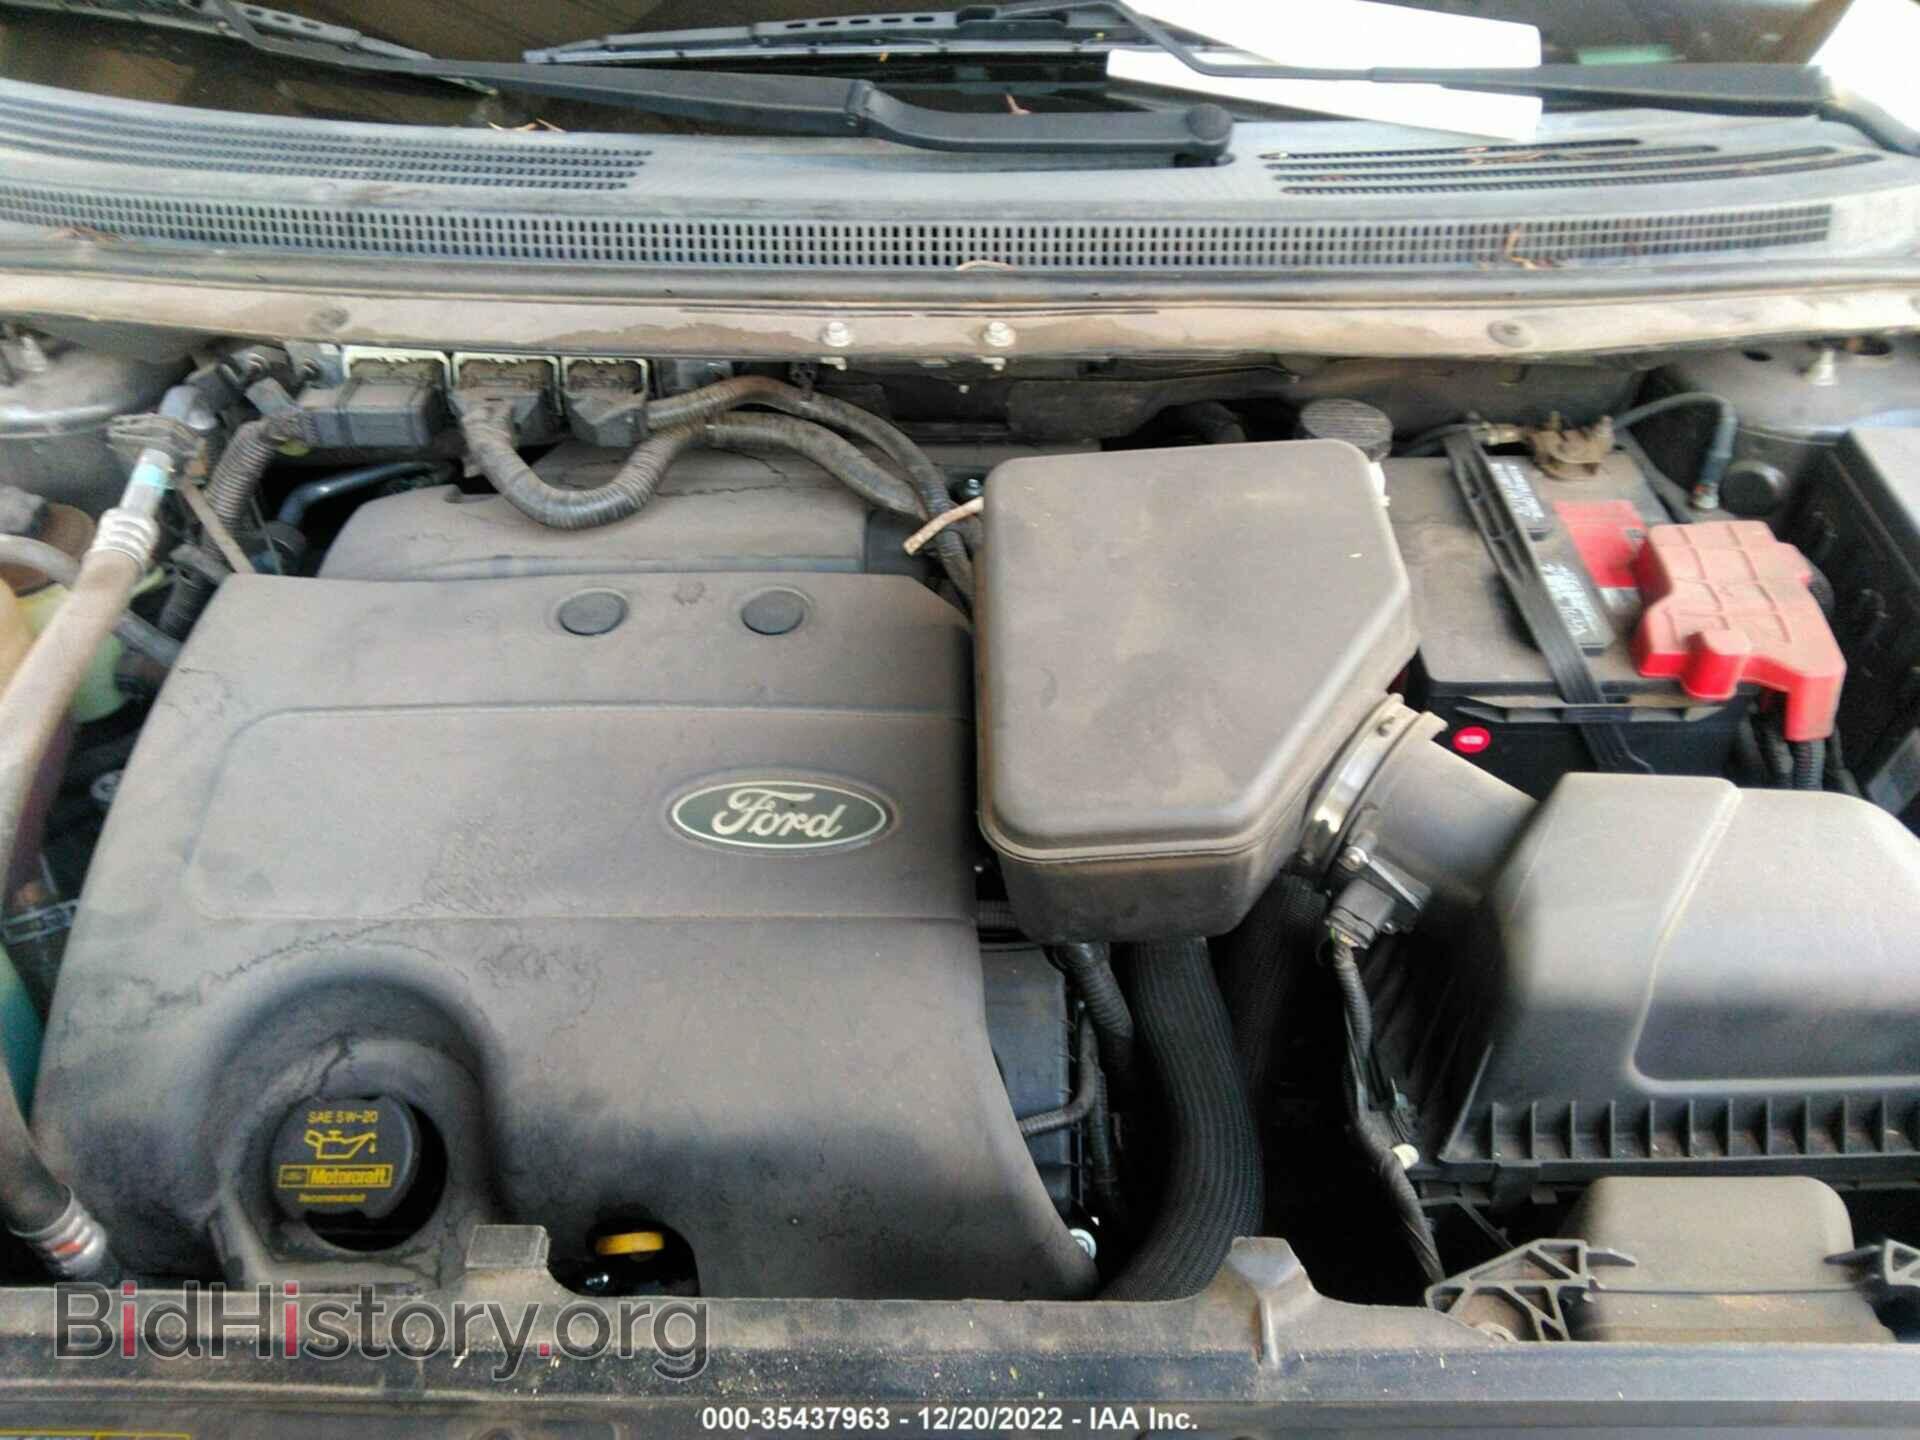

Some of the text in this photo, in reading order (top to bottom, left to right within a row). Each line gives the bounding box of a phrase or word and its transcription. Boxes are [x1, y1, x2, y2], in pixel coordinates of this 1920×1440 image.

[712, 788, 847, 838] Ford
[307, 1109, 378, 1124] SAE 5W-20
[310, 1167, 386, 1185] Motorcraft
